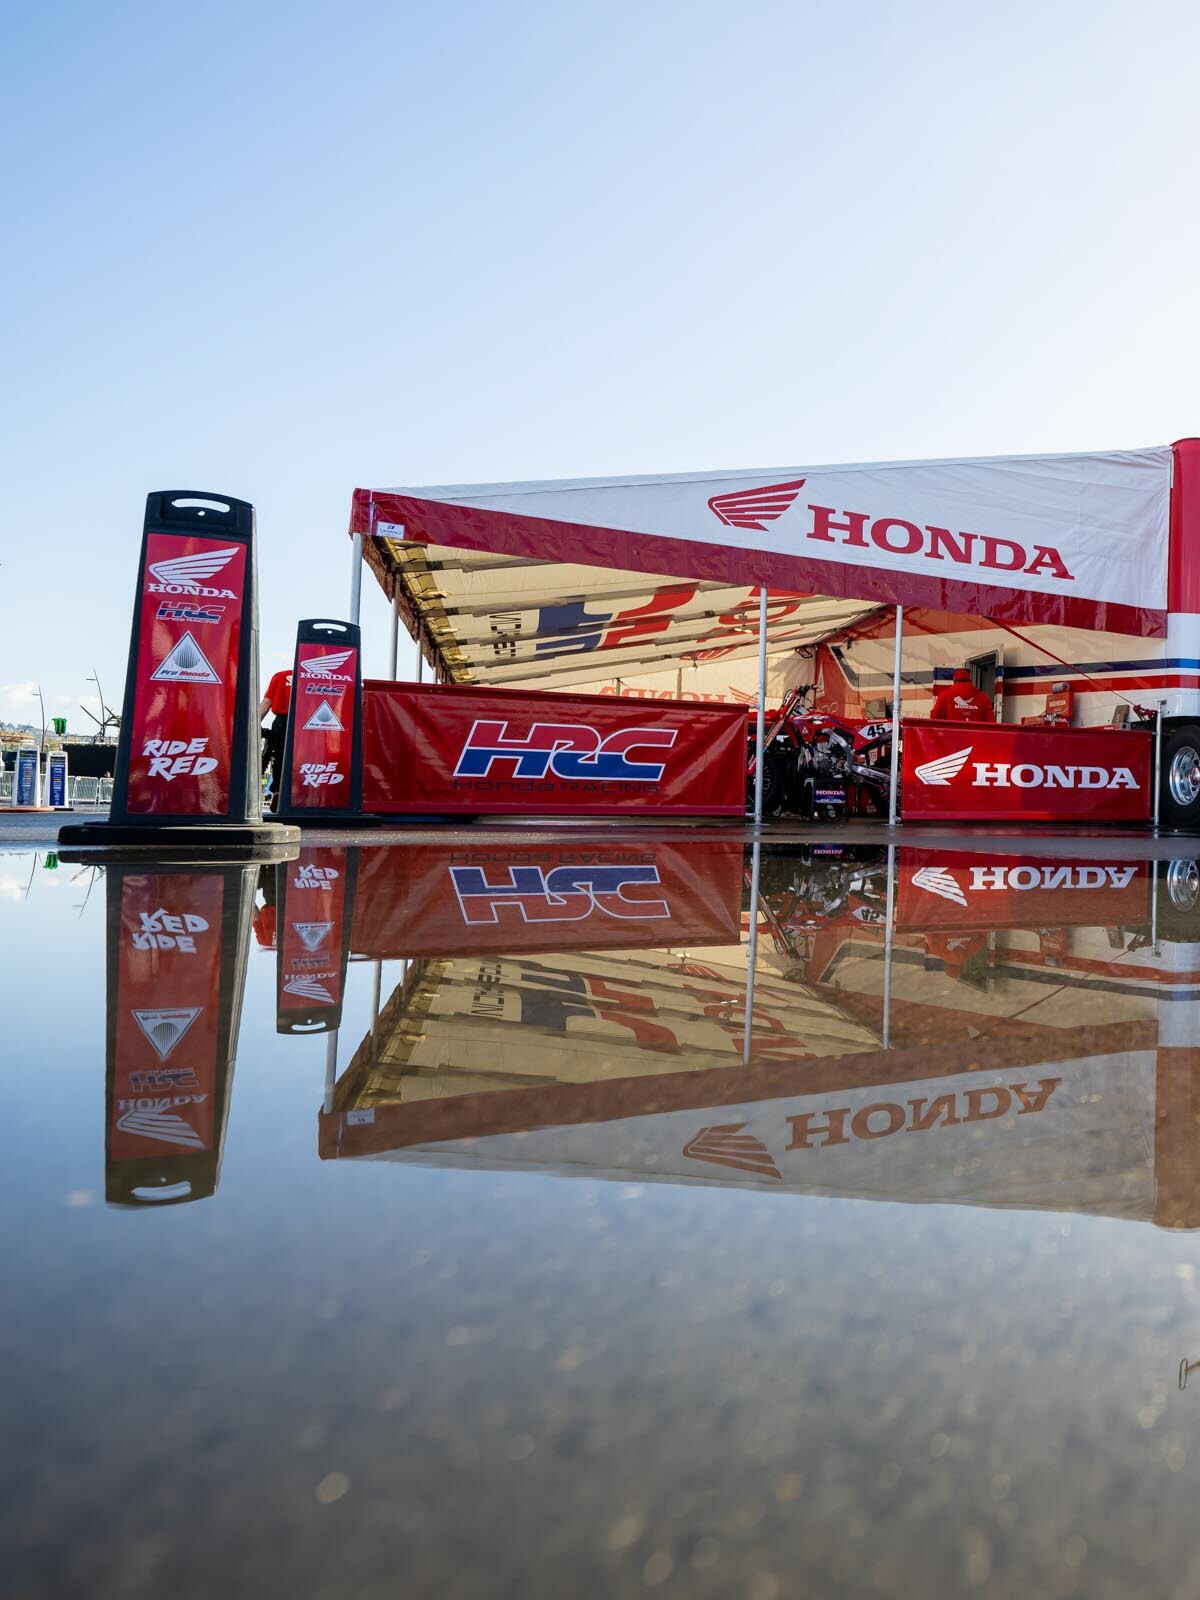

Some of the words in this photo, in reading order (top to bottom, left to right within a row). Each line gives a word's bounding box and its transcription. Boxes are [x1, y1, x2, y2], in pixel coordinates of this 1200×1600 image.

[806, 504, 1075, 580] HONDA
[147, 583, 238, 599] HONDA
[156, 601, 226, 621] HRC
[300, 672, 353, 681] HONDA
[867, 724, 886, 738] 45
[142, 737, 209, 758] RIDE
[453, 720, 679, 781] HRC
[147, 755, 219, 781] RED
[299, 762, 339, 774] RIDE
[971, 762, 1141, 789] HONDA
[303, 773, 344, 788] RED
[453, 779, 555, 792] Honda
[562, 781, 661, 794] RACING
